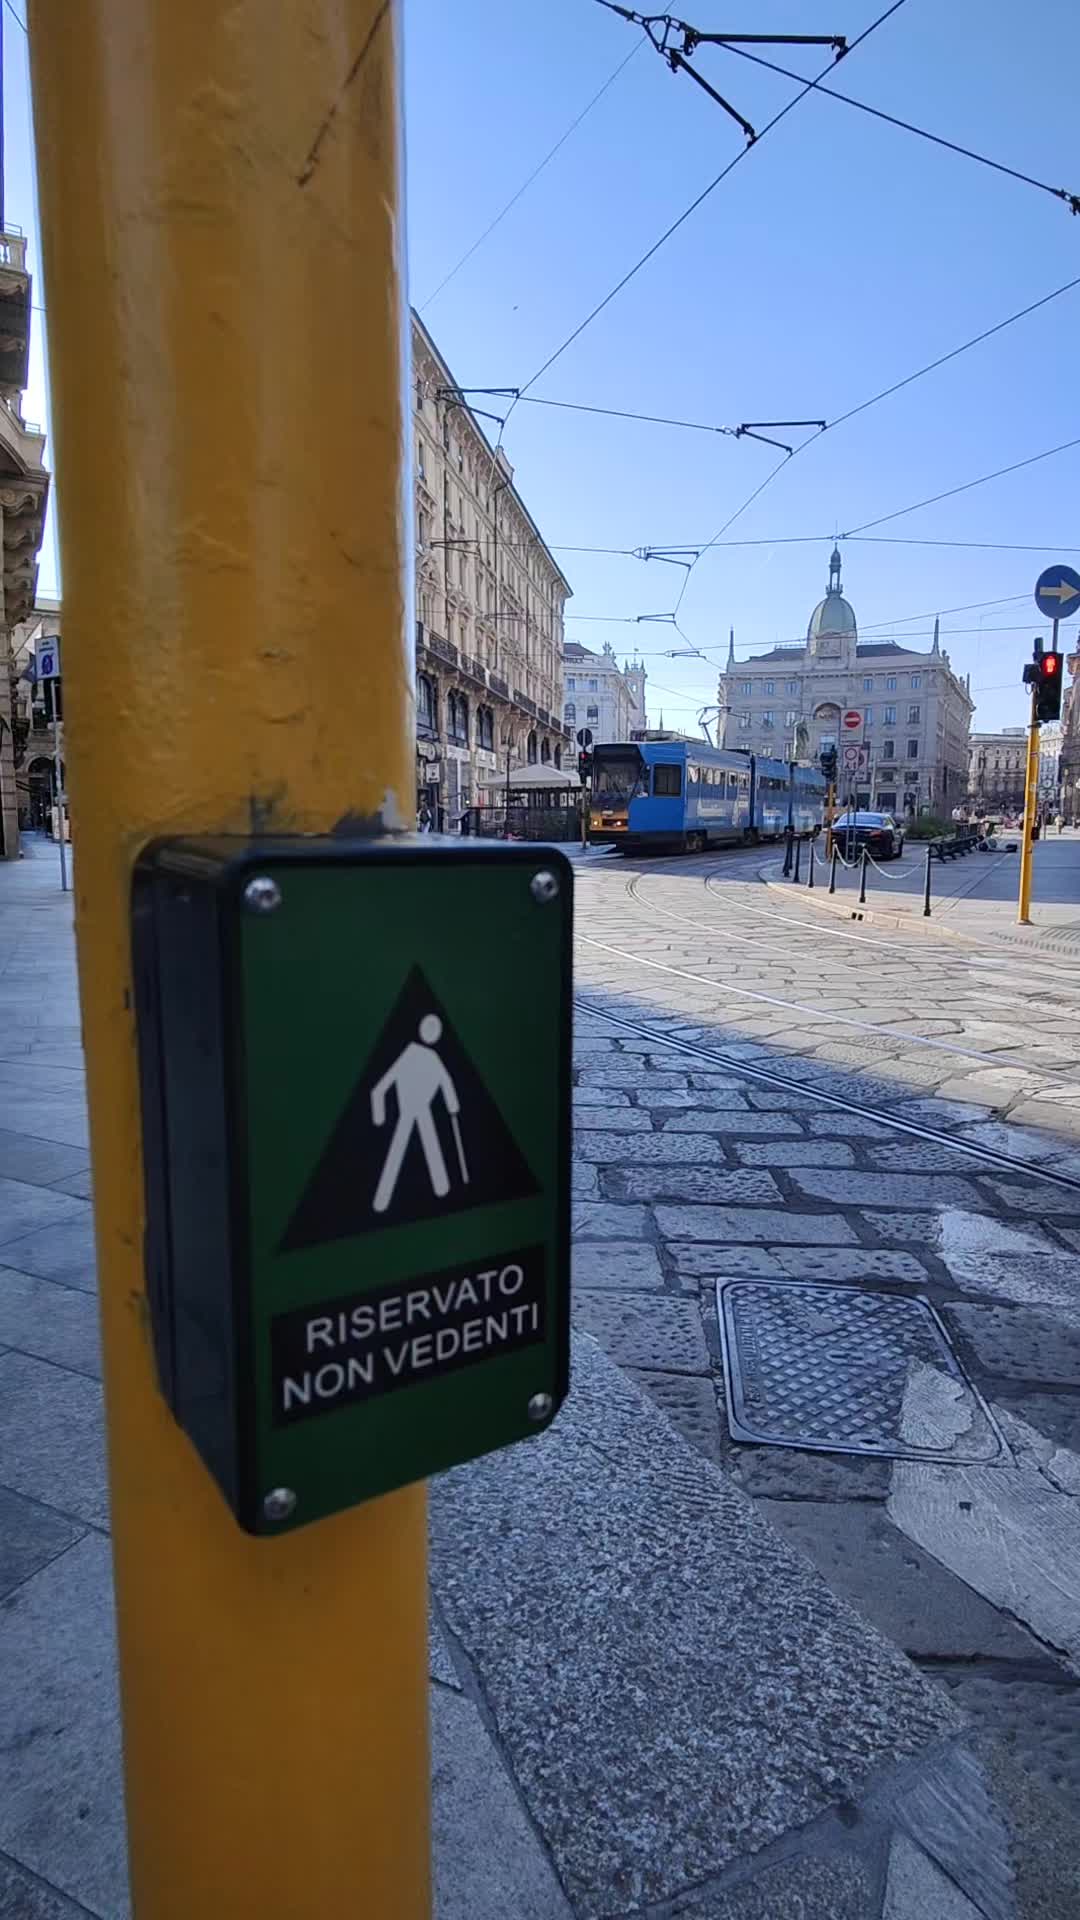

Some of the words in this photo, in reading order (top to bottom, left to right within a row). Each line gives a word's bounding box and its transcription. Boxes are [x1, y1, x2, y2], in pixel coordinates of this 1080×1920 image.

[283, 1353, 373, 1411] NON
[384, 1302, 538, 1375] VEDENTI
[307, 1264, 524, 1353] RISERVATO
